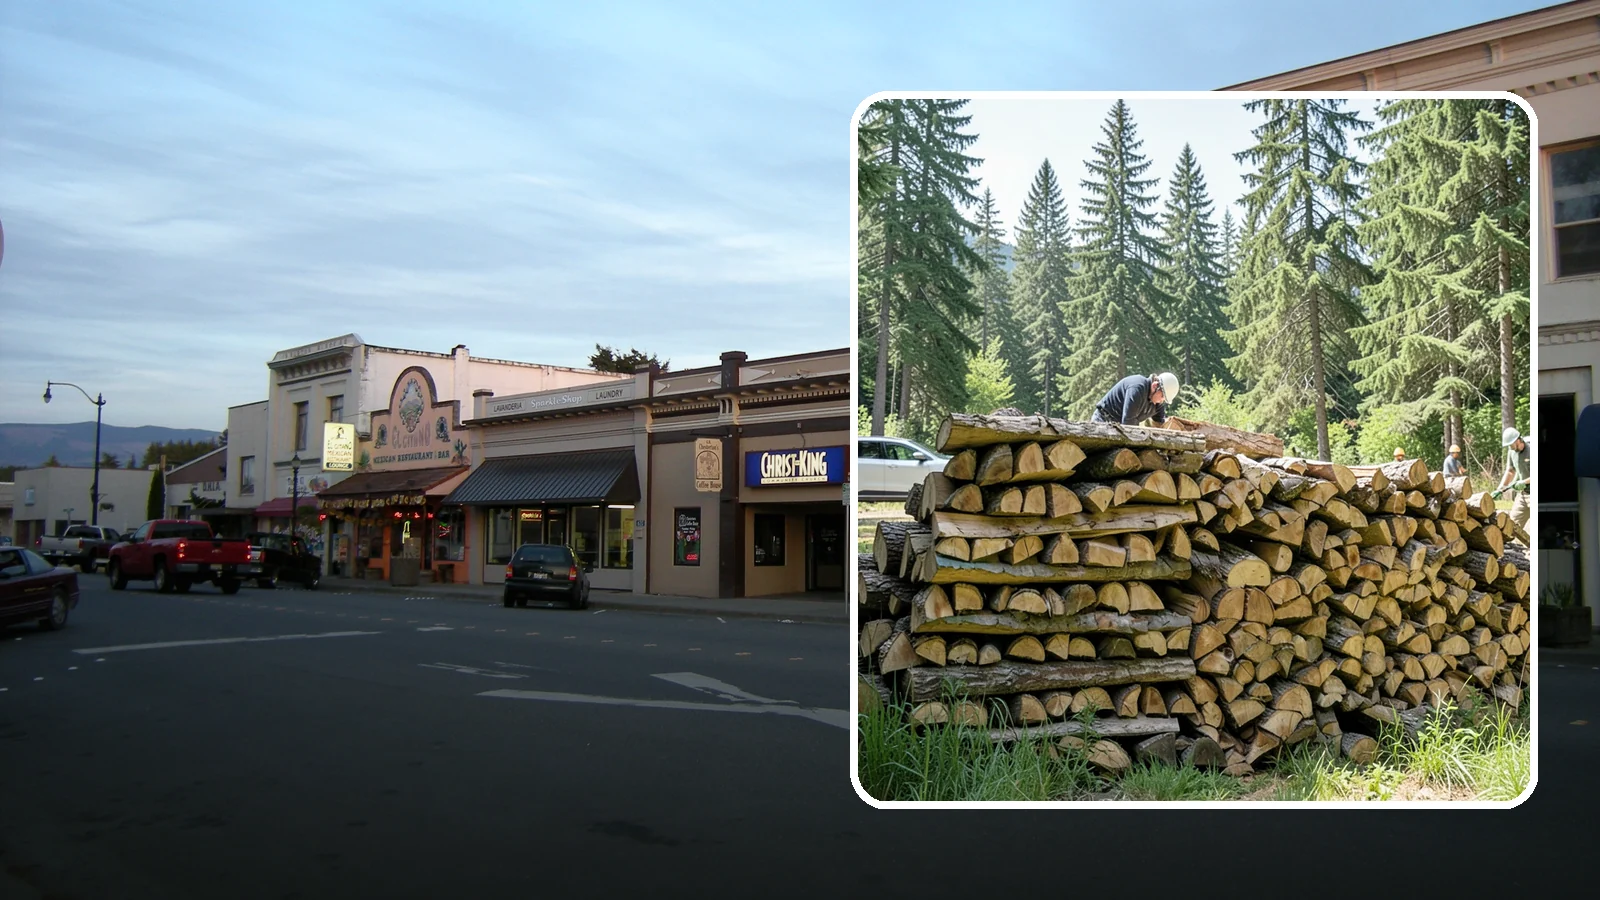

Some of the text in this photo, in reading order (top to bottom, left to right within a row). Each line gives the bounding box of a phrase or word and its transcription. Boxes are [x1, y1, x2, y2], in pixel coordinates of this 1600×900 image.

[595, 389, 623, 399] LAUNDRY
[494, 401, 523, 412] LAVANDERIA
[530, 395, 583, 409] Sparkle Shop
[374, 455, 396, 464] MEXICAN
[397, 451, 433, 462] RESTAURANT
[438, 450, 450, 459] BAR
[761, 450, 828, 477] CHRIST KING
